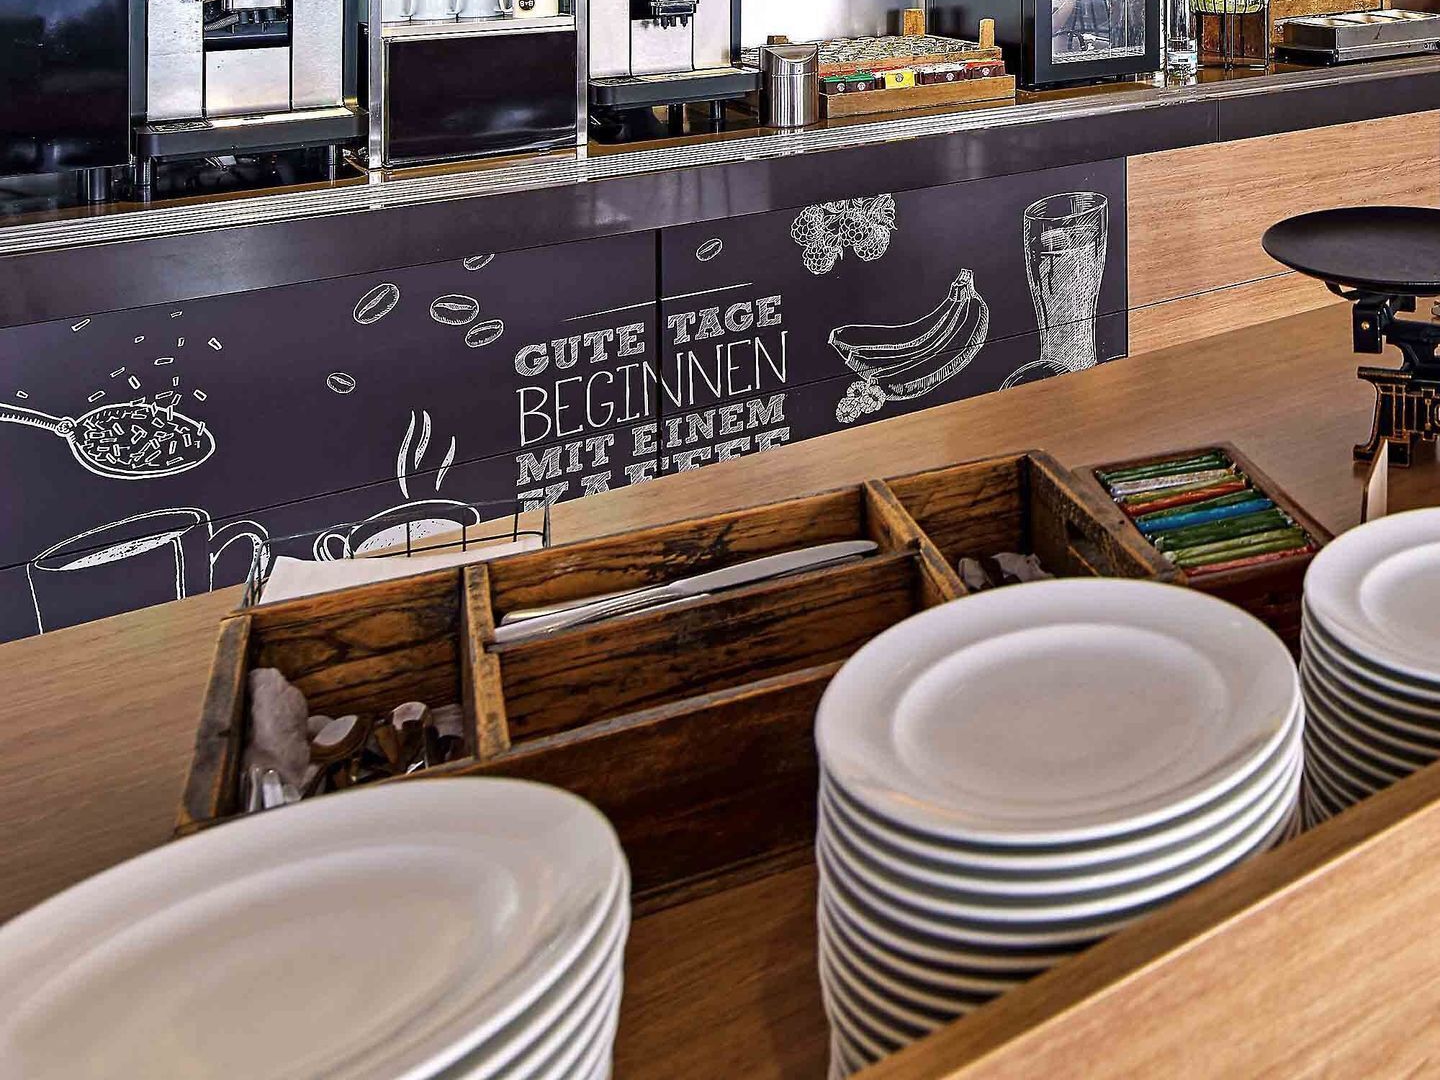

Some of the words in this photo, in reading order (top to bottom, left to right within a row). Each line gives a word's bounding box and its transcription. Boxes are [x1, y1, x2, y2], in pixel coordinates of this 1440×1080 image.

[514, 322, 645, 377] GUTE
[667, 294, 782, 345] TAGE
[515, 330, 789, 447] BEGINNEN
[516, 433, 614, 486] MIT
[632, 393, 787, 456] EINEM
